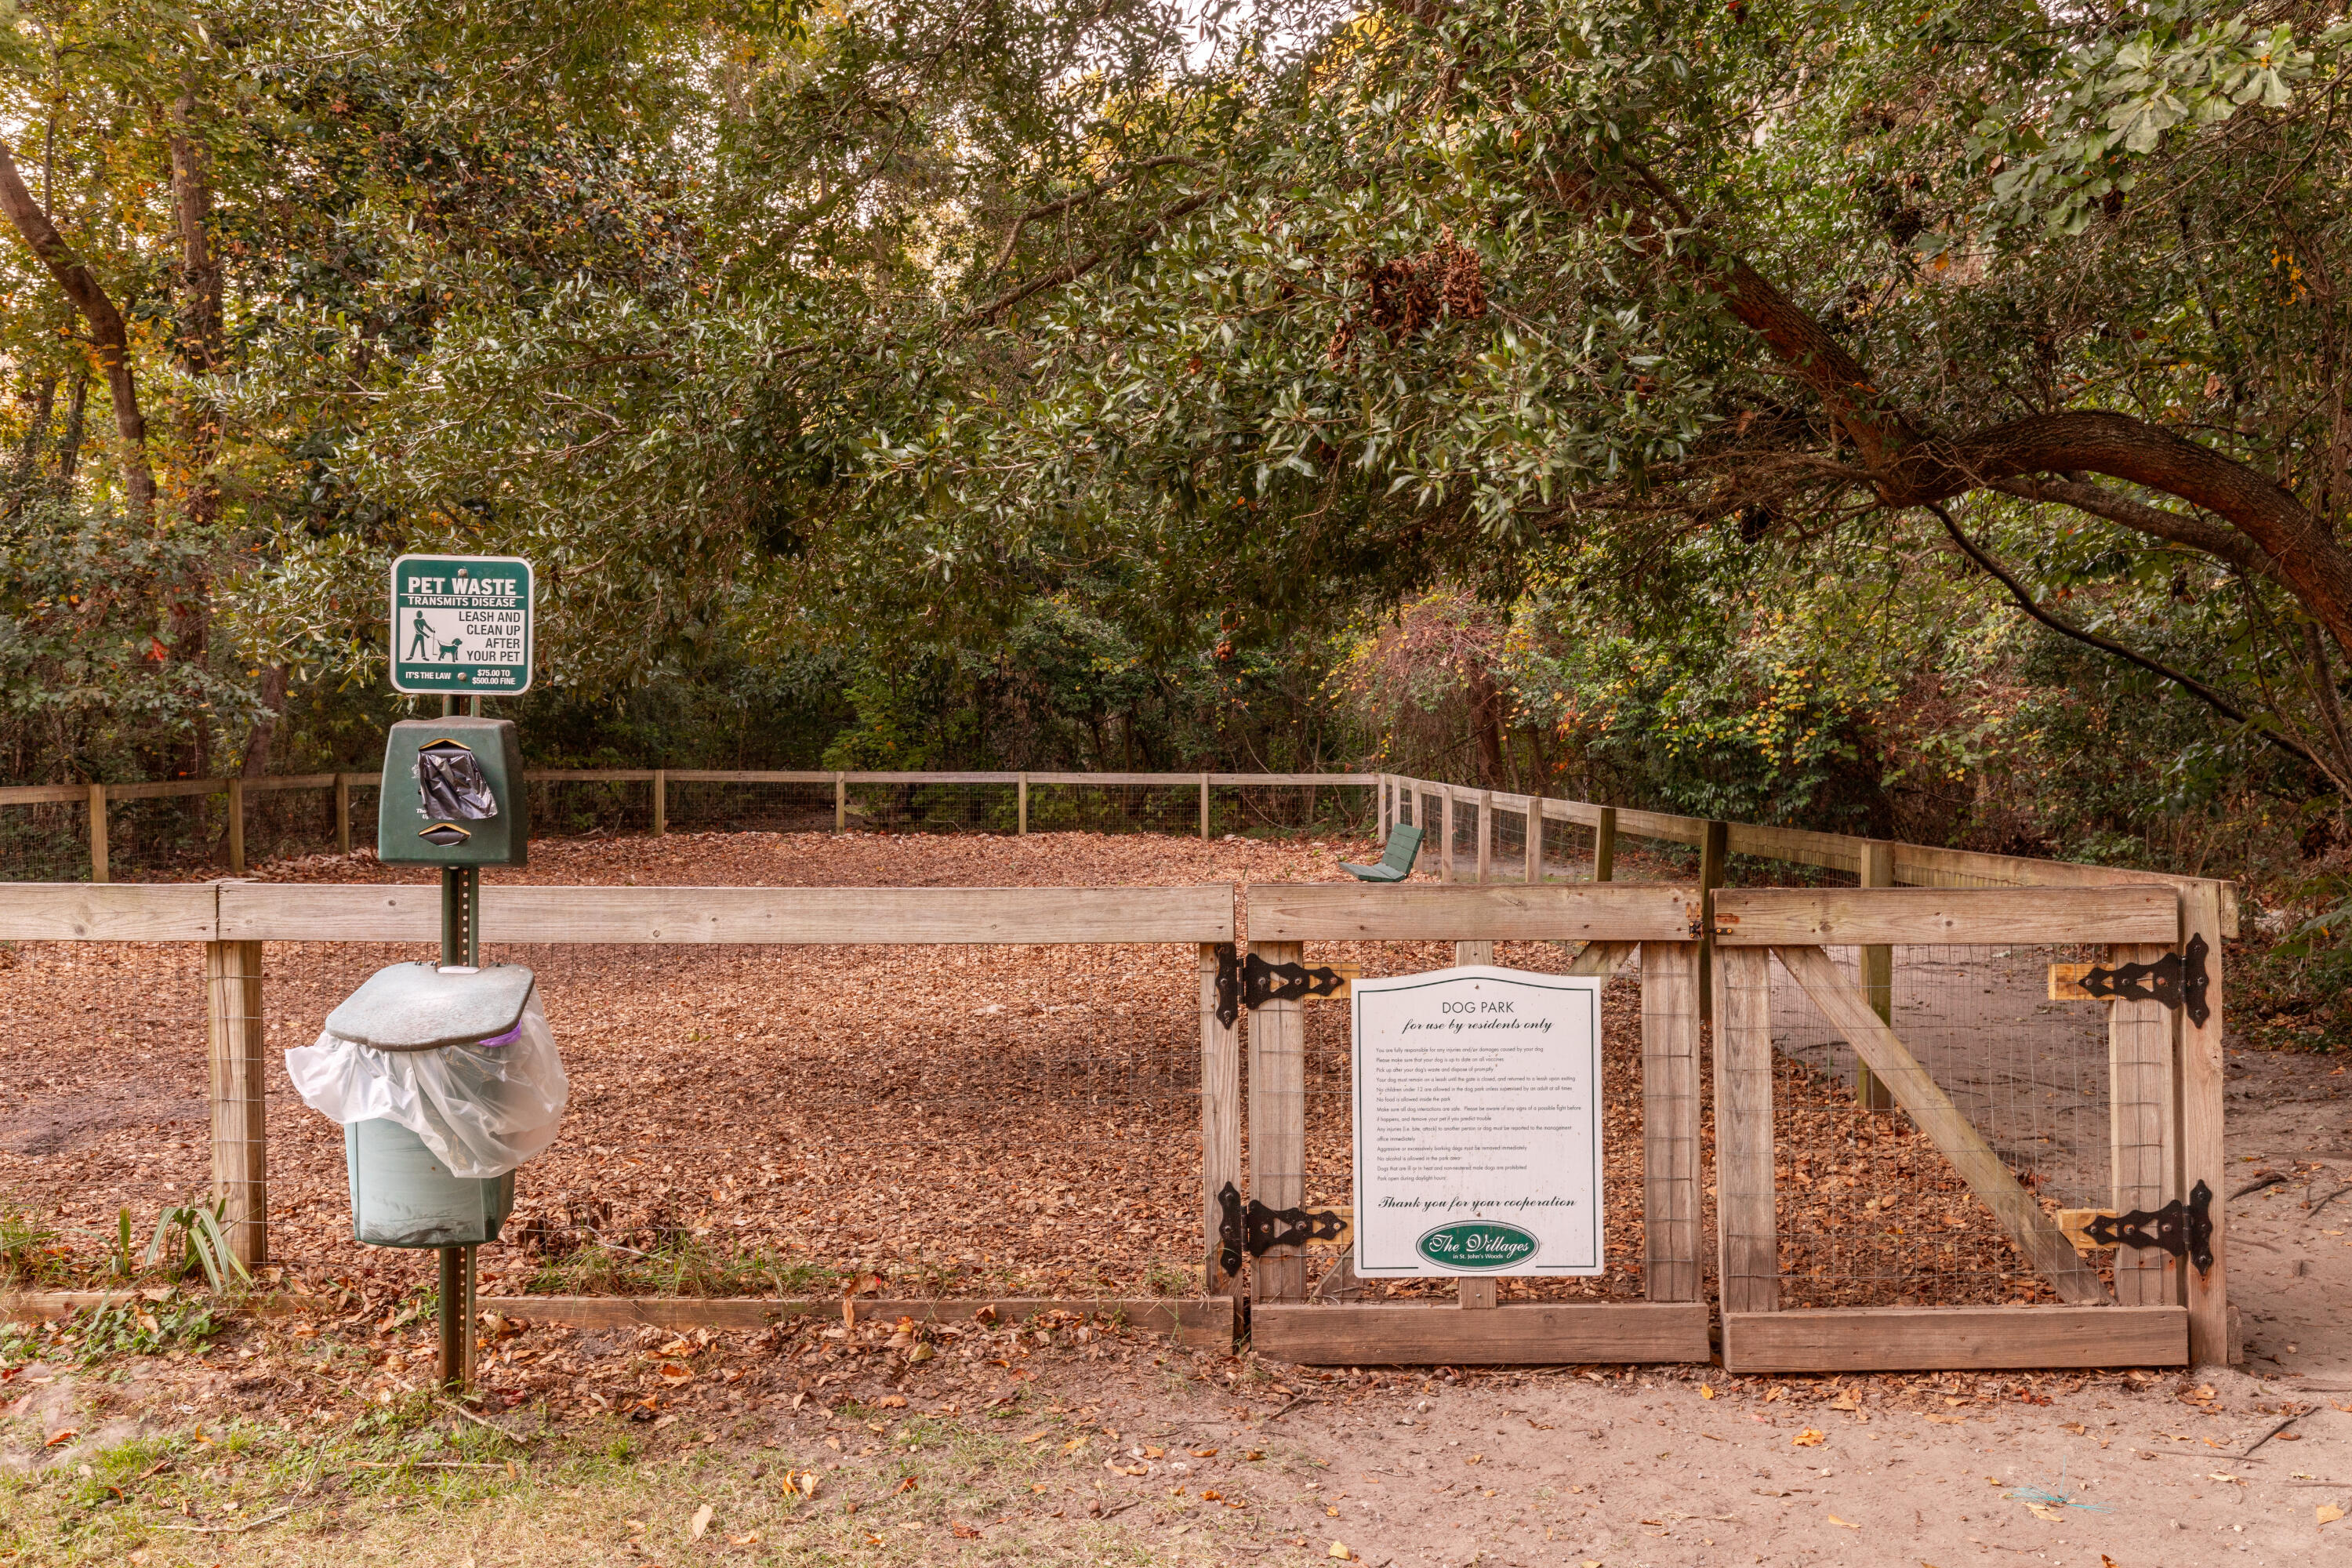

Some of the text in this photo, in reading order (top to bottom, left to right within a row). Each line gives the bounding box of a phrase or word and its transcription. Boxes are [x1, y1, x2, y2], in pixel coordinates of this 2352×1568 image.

[408, 577, 517, 595] PET WASTE
[408, 597, 516, 607] TRANSMITS DISEASE
[459, 612, 520, 622] LEASH AND
[466, 625, 520, 635] CLEAN UP
[485, 638, 520, 648] AFTER
[466, 651, 520, 662] YOUR PET
[1443, 1002, 1514, 1014] DOG PARK
[1402, 1019, 1423, 1034] for
[1449, 1019, 1465, 1034] by
[1468, 1018, 1519, 1029] residents
[1524, 1018, 1555, 1033] only
[1378, 1196, 1577, 1212] Thank you for your cooperation
[1429, 1234, 1528, 1258] The Villages
